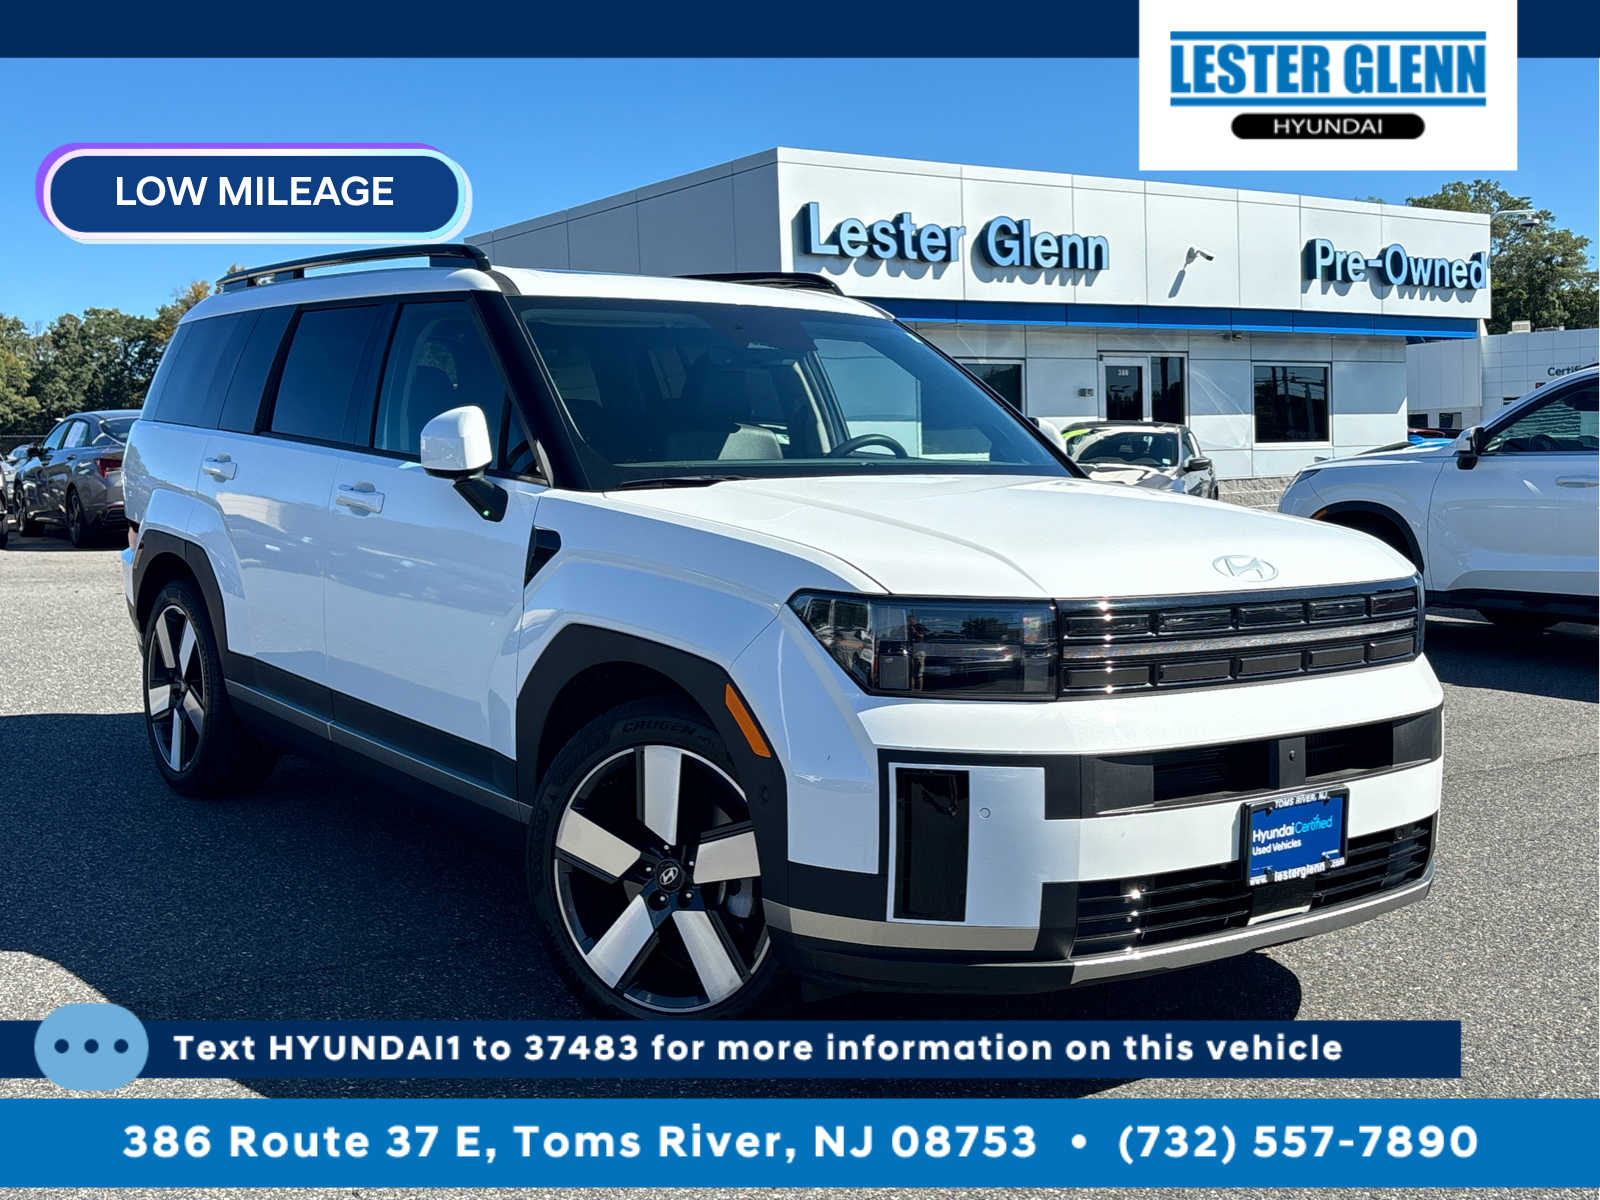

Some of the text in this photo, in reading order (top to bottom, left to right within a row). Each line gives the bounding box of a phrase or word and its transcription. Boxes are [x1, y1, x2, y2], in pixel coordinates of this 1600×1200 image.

[804, 201, 1110, 272] Lester Glenn
[1308, 238, 1487, 290] Pre-Owned
[1274, 797, 1294, 809] TOMS
[1252, 839, 1302, 856] Used Vehicles
